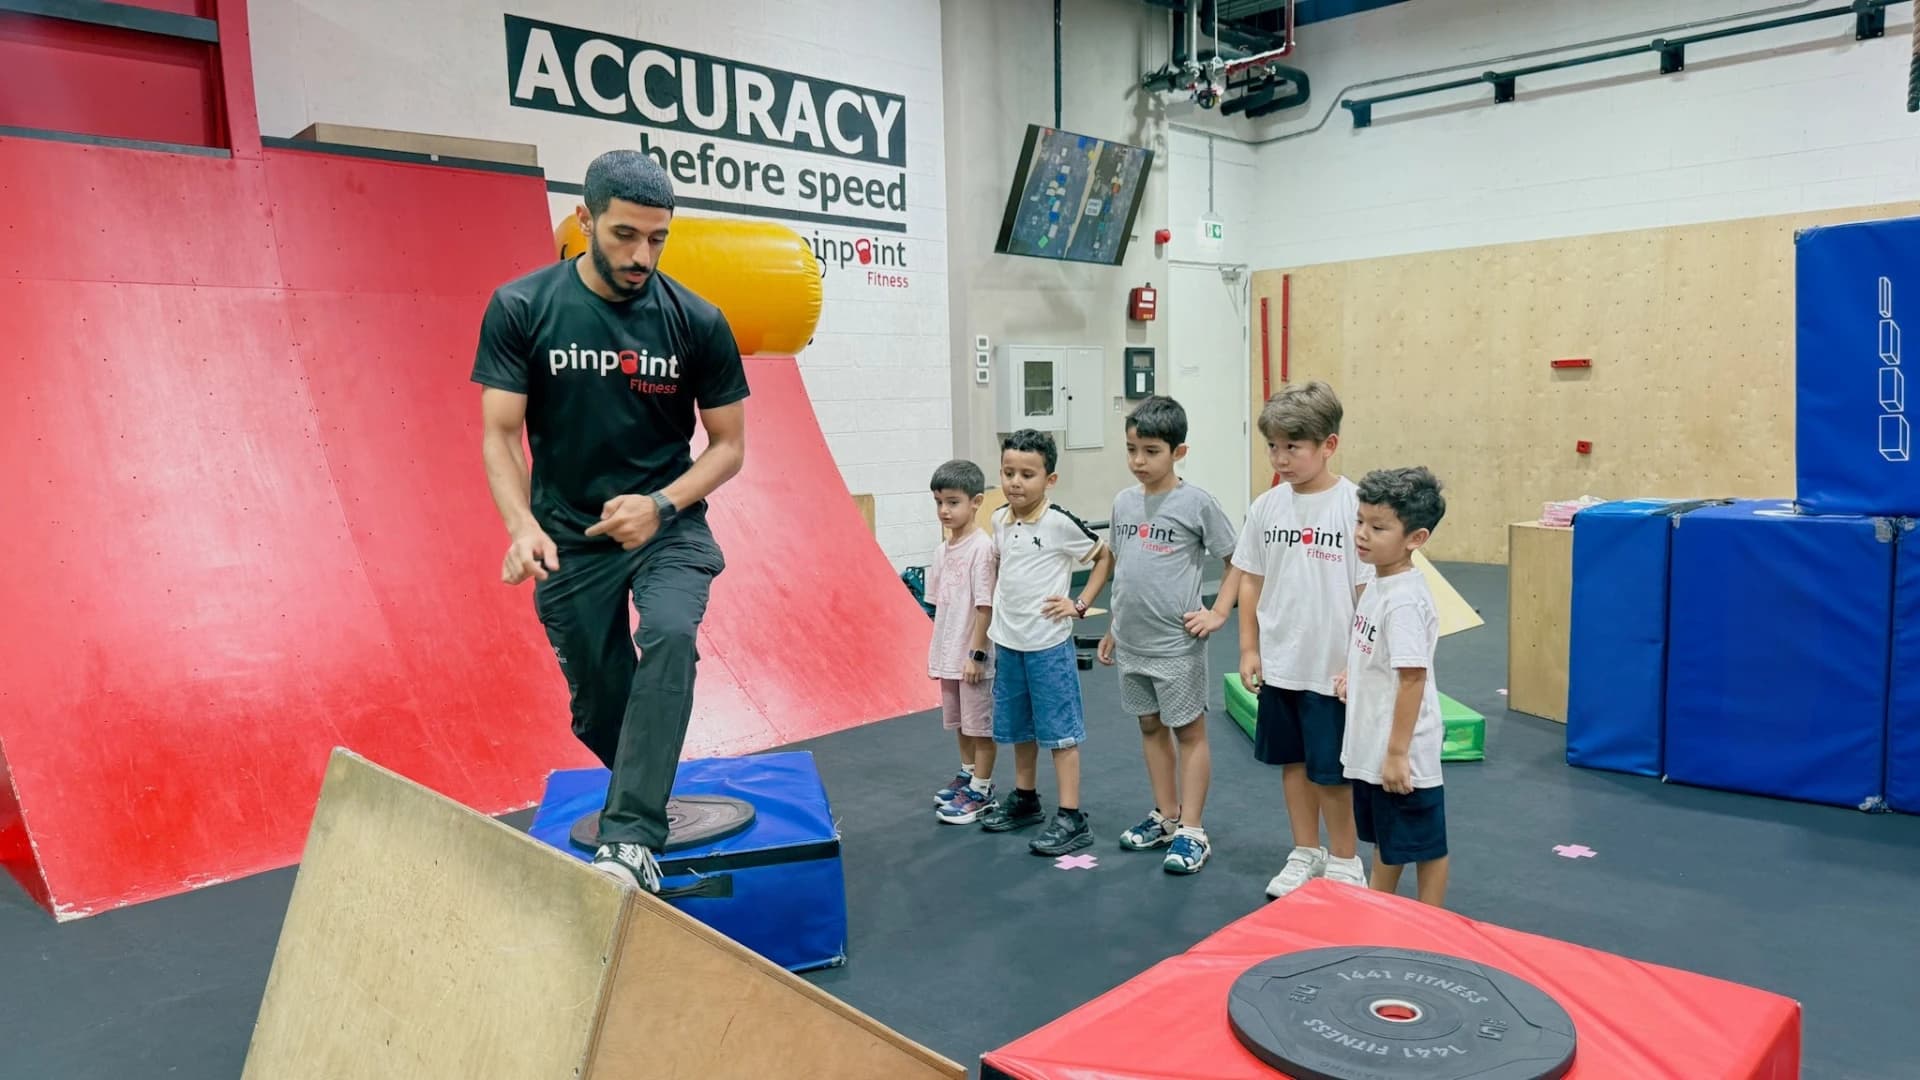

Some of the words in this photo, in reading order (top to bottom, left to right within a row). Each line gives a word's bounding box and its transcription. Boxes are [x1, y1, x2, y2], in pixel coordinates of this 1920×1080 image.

[514, 27, 903, 160] ACCURACY
[640, 132, 785, 195] before
[798, 173, 907, 212] speed
[867, 271, 909, 288] Fitness
[629, 378, 678, 394] Fitness
[1306, 548, 1343, 562] Fitness
[1403, 971, 1489, 1004] FITNESS
[1303, 1018, 1390, 1056] FITNESS
